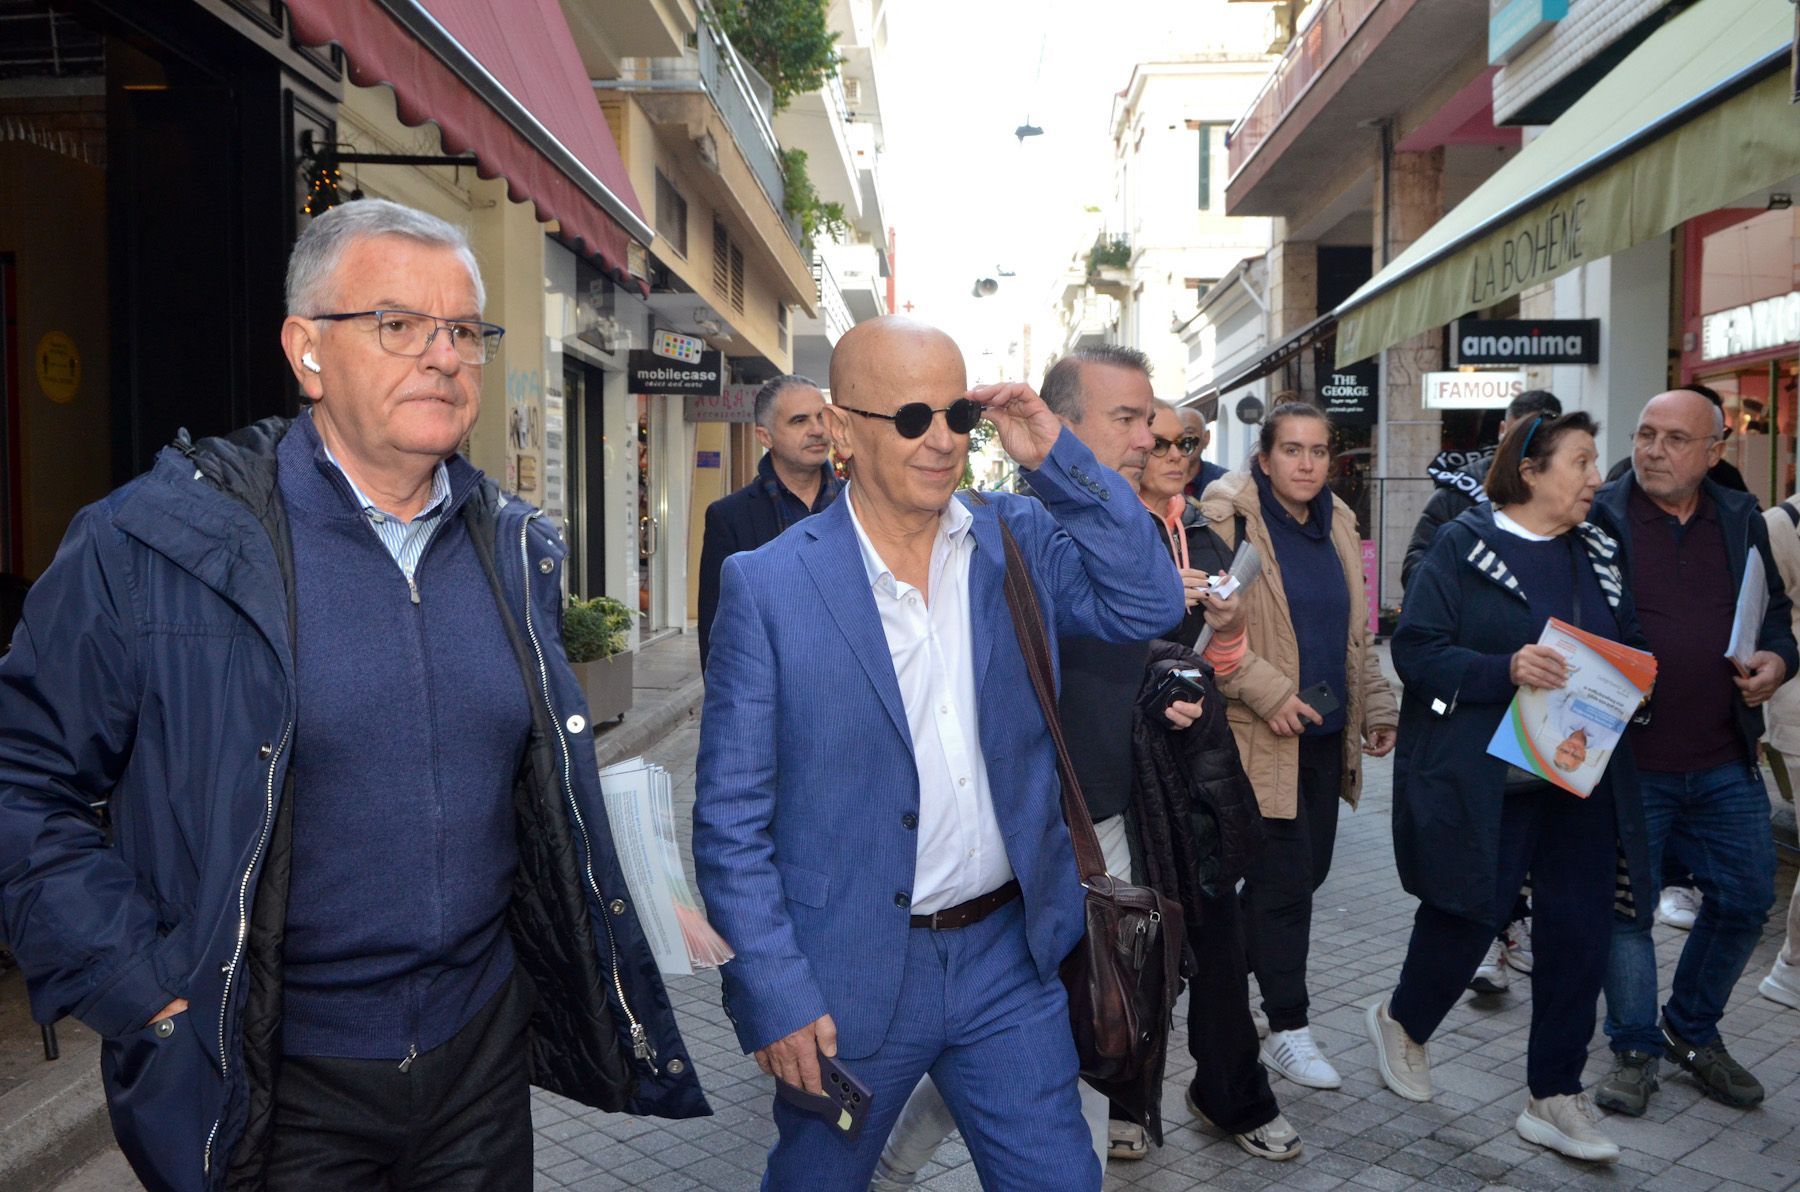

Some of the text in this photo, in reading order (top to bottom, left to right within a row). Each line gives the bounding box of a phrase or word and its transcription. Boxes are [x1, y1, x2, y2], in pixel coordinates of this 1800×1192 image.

[1472, 254, 1496, 304] LA
[1462, 327, 1582, 356] anonima
[637, 368, 717, 381] mobilecase
[1331, 374, 1357, 386] THE
[1321, 385, 1369, 397] GEORGE
[1439, 380, 1523, 399] FAMOUS
